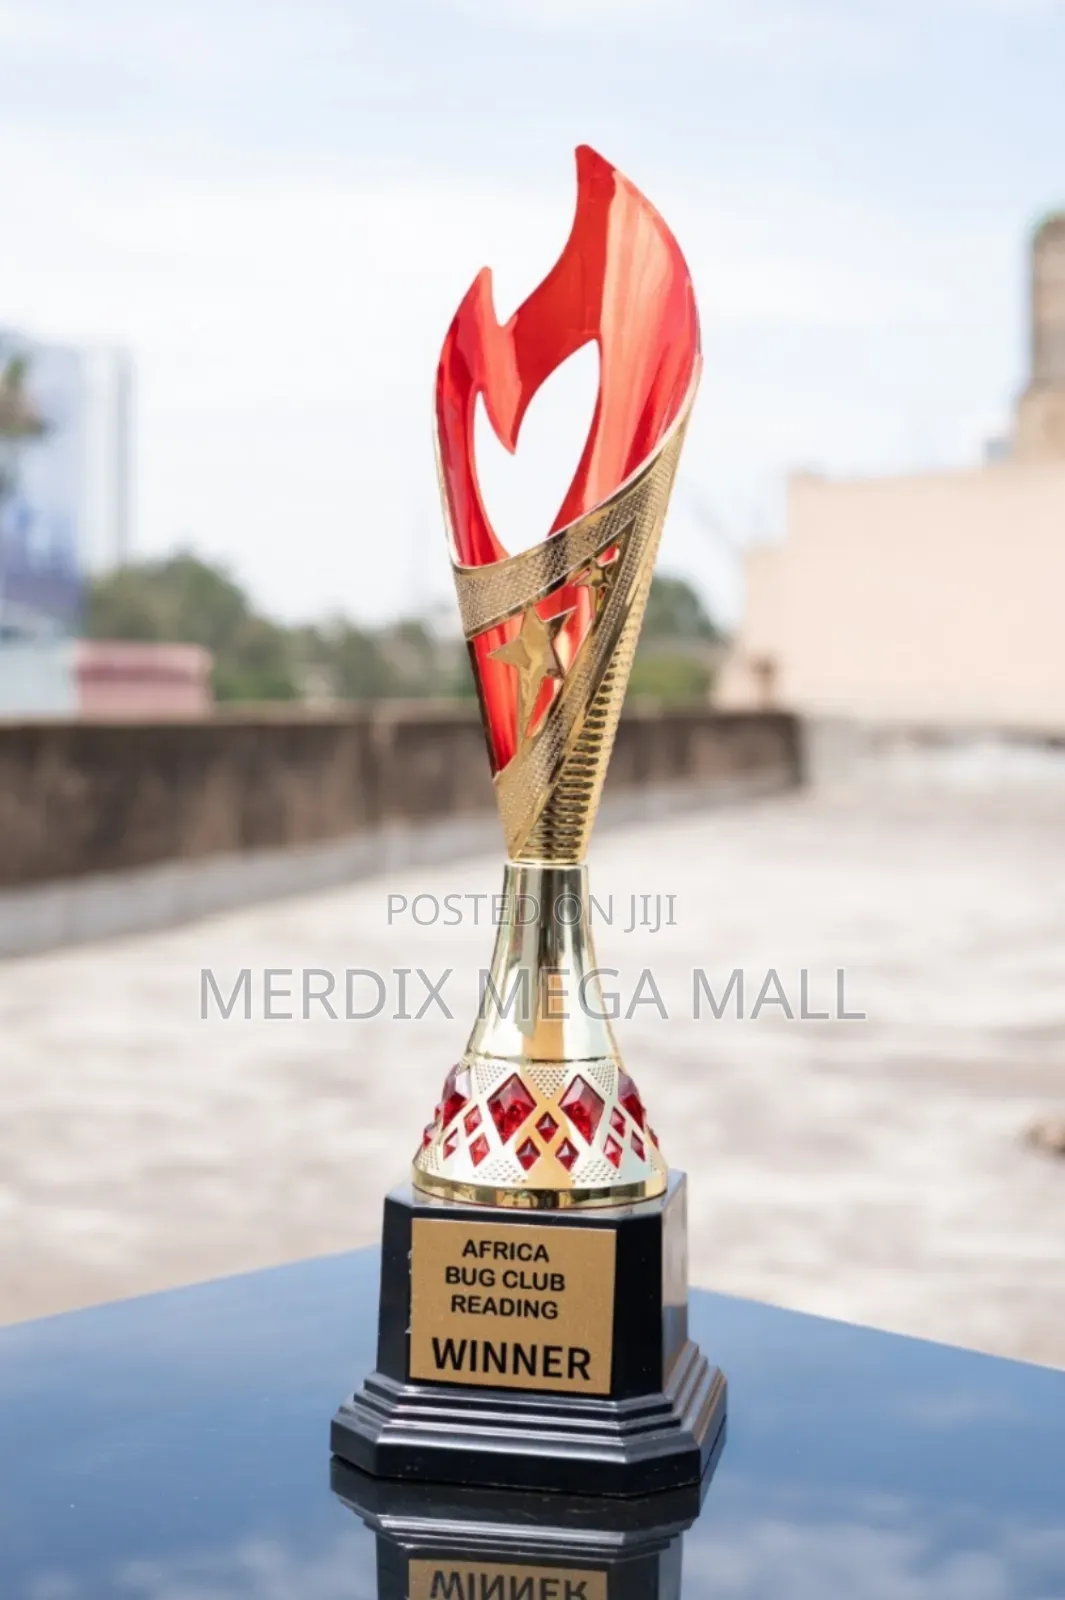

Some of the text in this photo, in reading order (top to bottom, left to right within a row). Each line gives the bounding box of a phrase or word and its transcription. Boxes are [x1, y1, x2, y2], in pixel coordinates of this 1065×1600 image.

[462, 1239, 549, 1262] AFRICA
[445, 1266, 565, 1291] BUG CLUB
[451, 1295, 558, 1319] READING
[431, 1337, 591, 1380] WINNER
